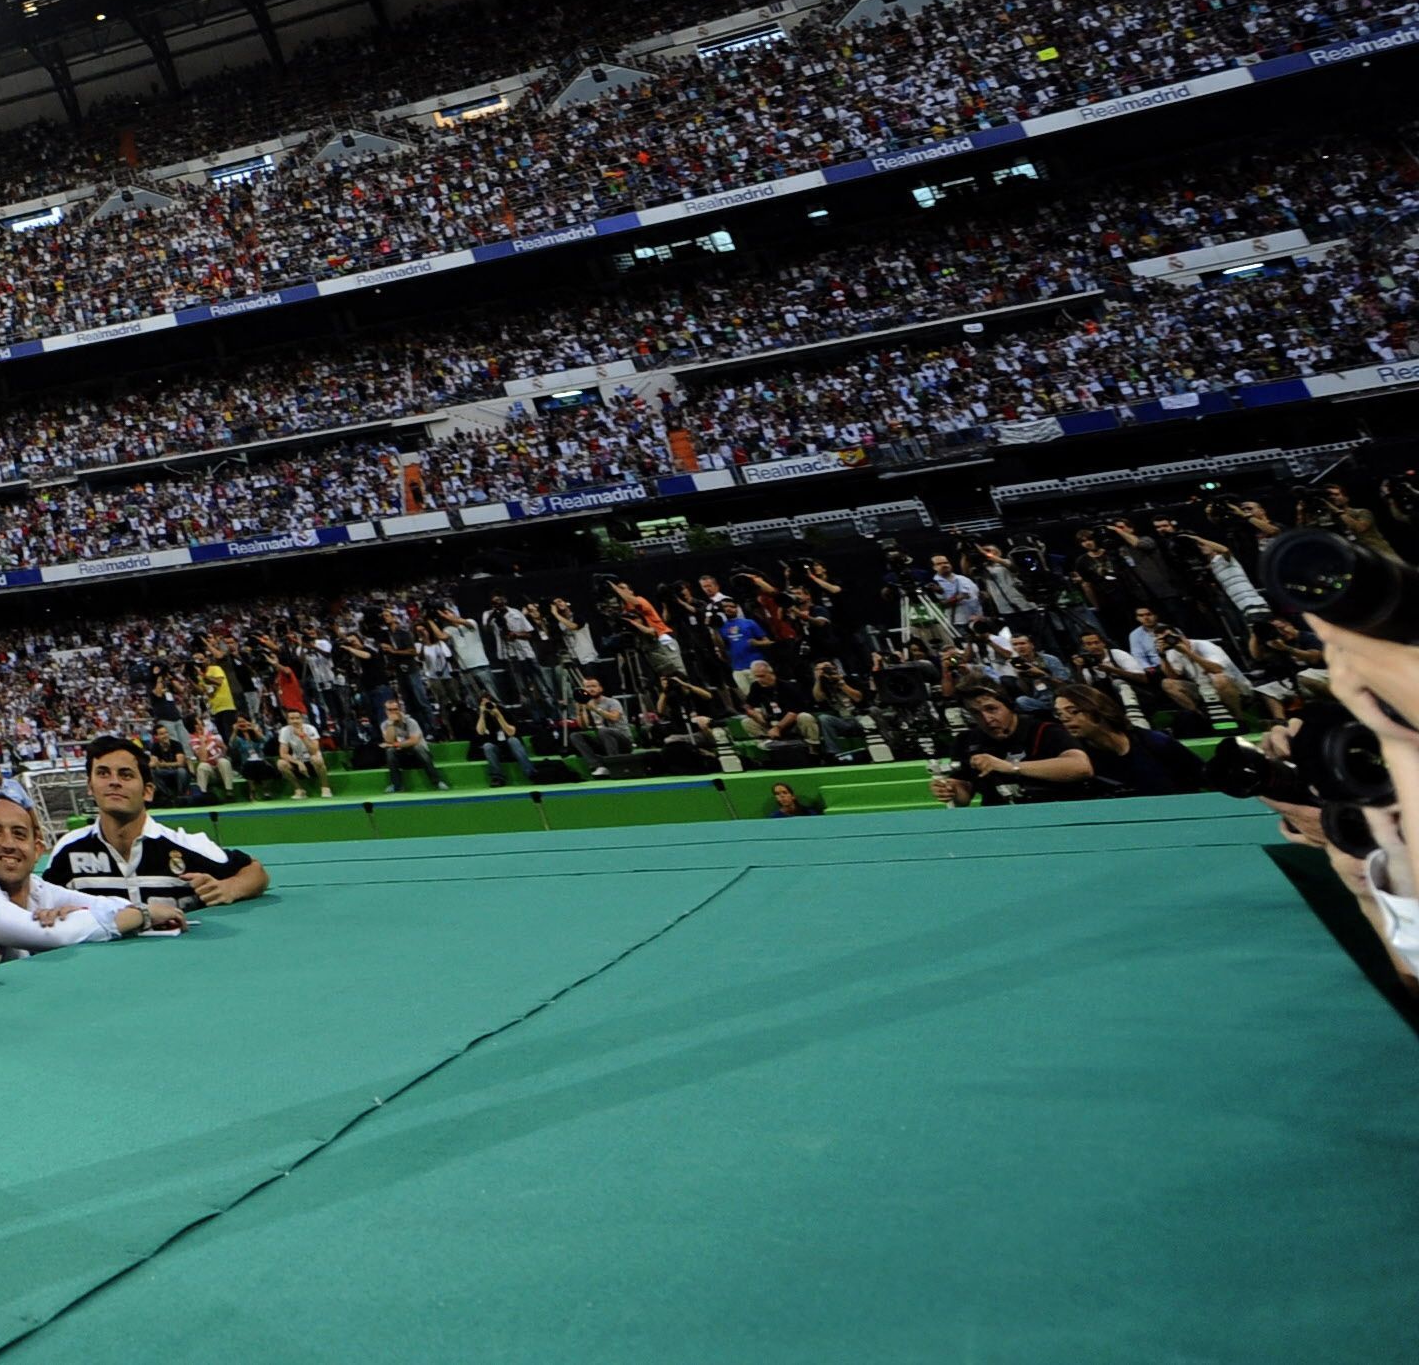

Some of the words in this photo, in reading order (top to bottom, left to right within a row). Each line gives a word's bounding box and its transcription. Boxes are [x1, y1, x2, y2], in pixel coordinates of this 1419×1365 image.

[1082, 85, 1191, 121] Realmadrid
[873, 139, 972, 170] Realmadrid
[685, 186, 773, 213] Realmadrid
[513, 225, 595, 252] Realmadrid
[357, 264, 431, 285] Realmadrid
[210, 294, 280, 317] Realmadrid
[77, 323, 140, 341] Realmadrid
[550, 484, 645, 510] Realmadrid
[80, 556, 150, 575] Realmadrid
[69, 851, 111, 874] RM
